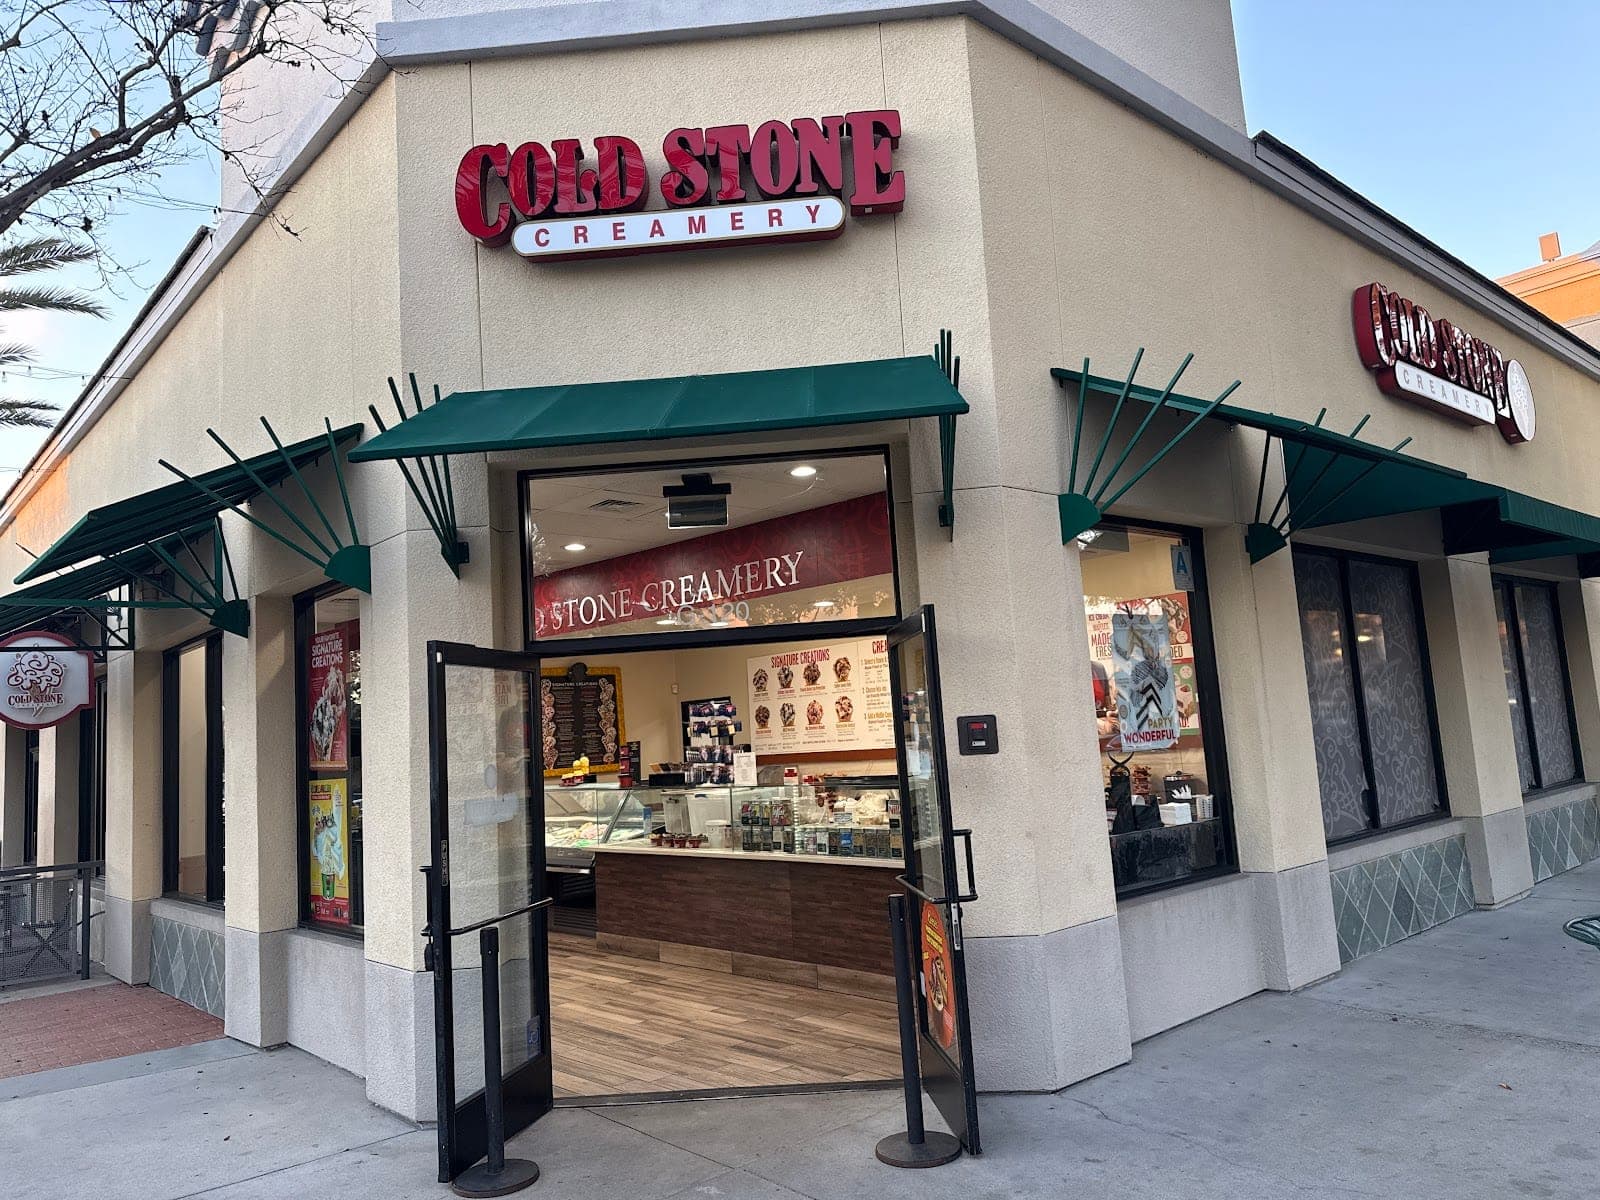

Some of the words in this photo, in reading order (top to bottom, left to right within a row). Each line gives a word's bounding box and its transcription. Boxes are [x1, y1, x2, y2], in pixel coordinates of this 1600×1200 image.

[455, 136, 648, 240] COLD
[660, 109, 906, 210] STONE
[534, 204, 821, 248] CREAMERY
[1402, 369, 1490, 417] CREAMERY
[1176, 551, 1188, 574] A
[551, 588, 633, 630] STONE
[641, 551, 804, 612] CREAMERY
[312, 639, 343, 657] SIGNATURE
[1091, 632, 1111, 647] MADE
[312, 651, 343, 668] CREATIONS
[771, 652, 799, 668] SIGNATURE
[800, 648, 830, 664] CREATIONS
[1096, 645, 1112, 658] FRES
[8, 695, 31, 705] COLD
[33, 693, 63, 704] STONE
[1148, 715, 1174, 729] PARTY
[1124, 729, 1177, 744] WONDERFUL
